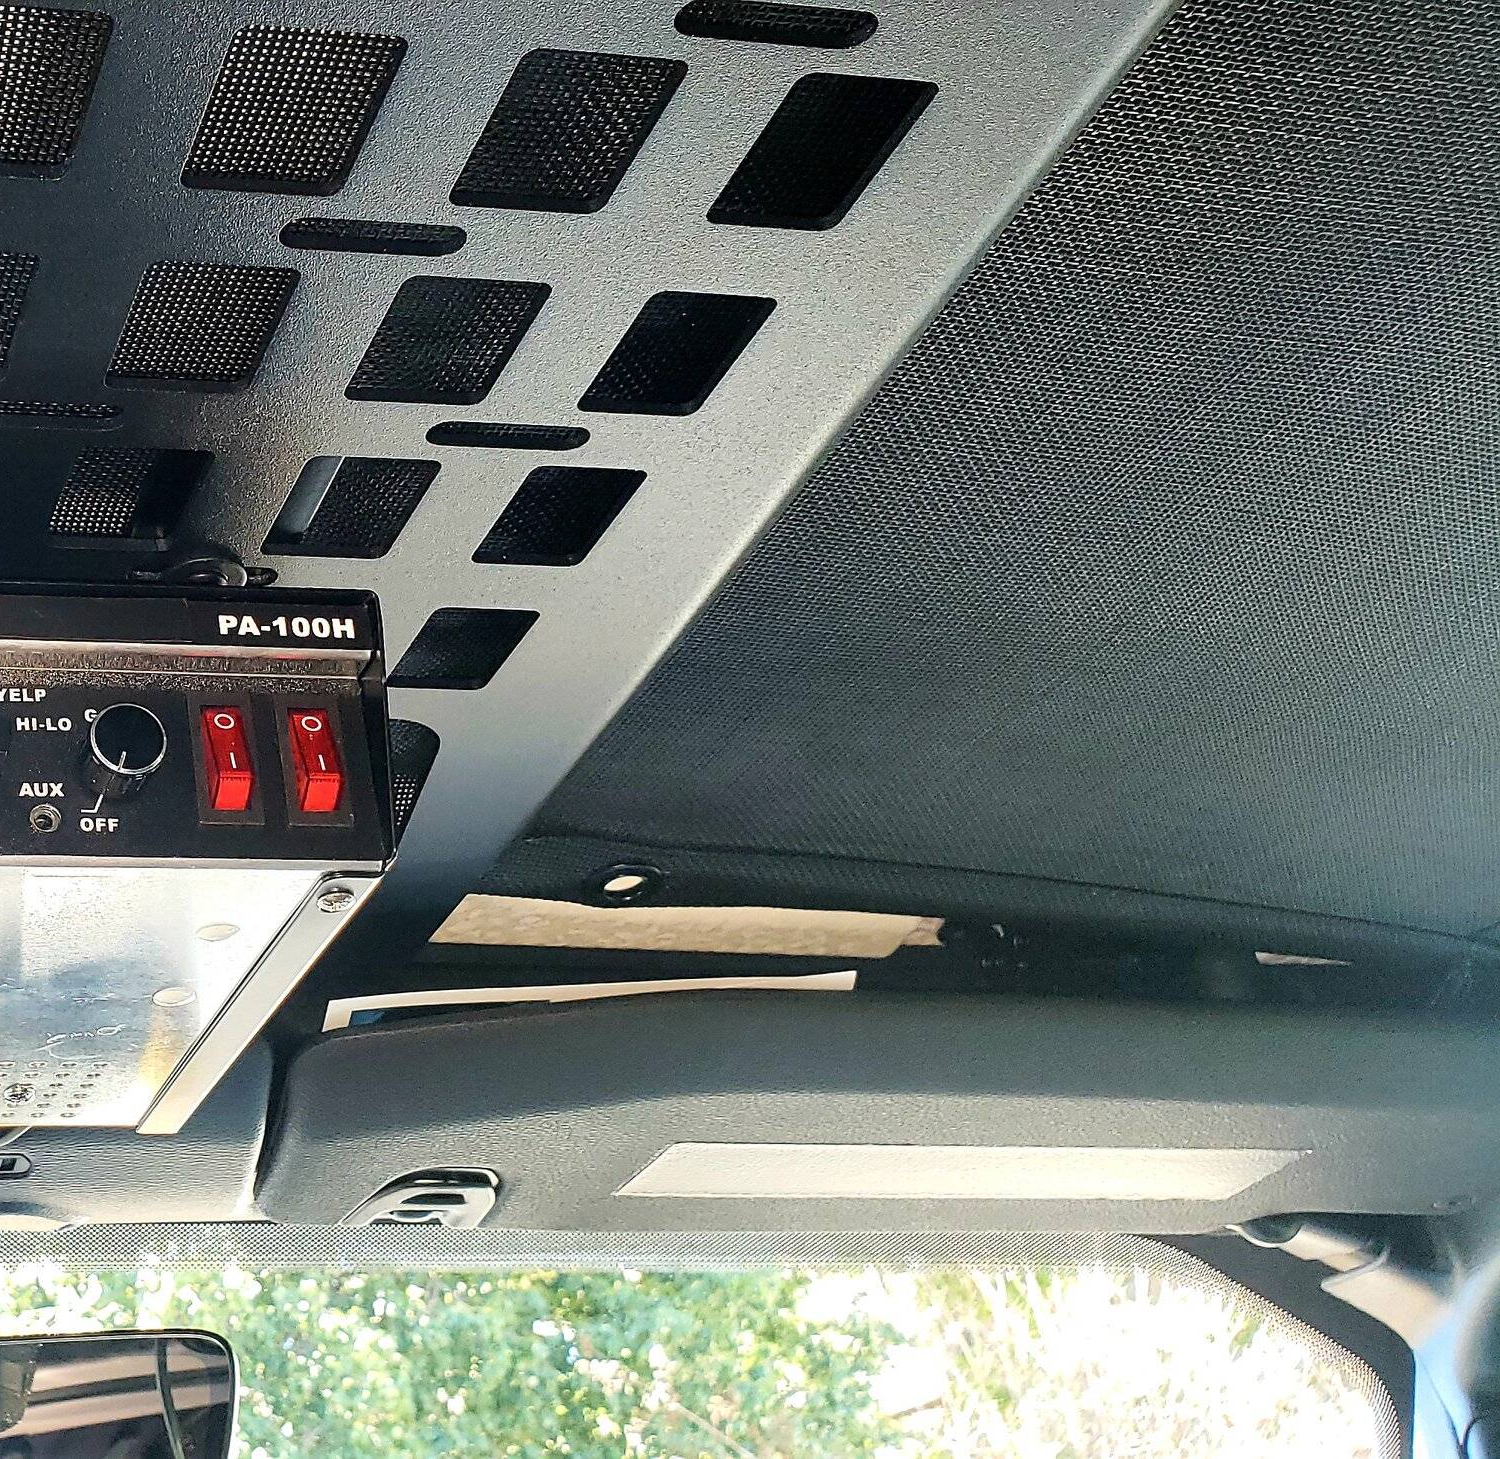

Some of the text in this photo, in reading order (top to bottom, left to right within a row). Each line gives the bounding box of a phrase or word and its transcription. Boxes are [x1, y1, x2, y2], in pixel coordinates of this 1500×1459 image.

[217, 614, 356, 640] PA-100H
[15, 717, 73, 732] HI-LO
[18, 782, 65, 798] AUX
[79, 817, 119, 833] OFF
